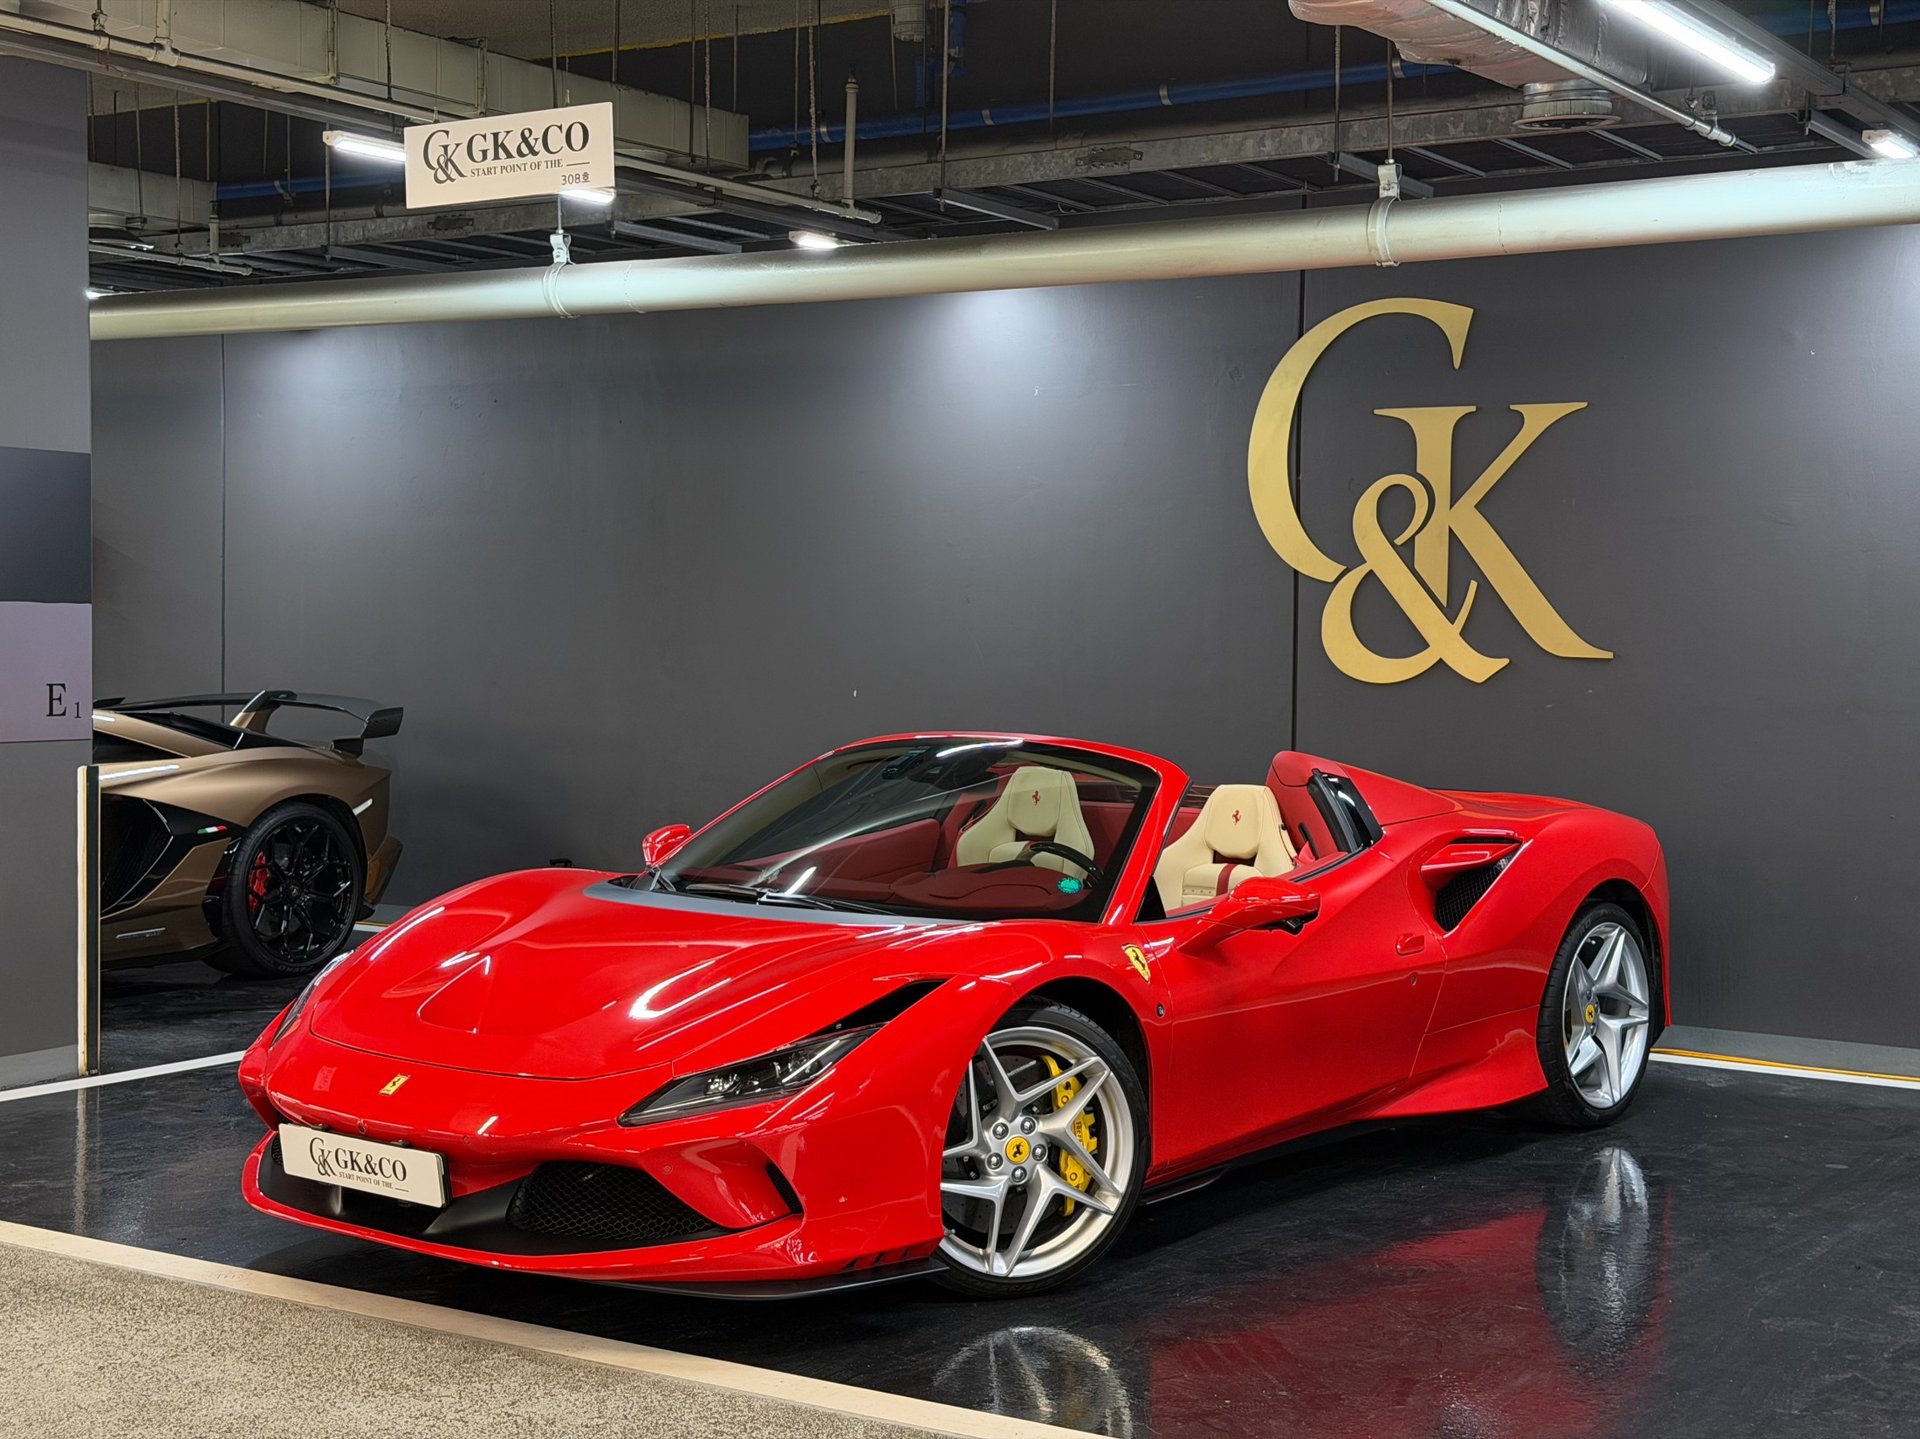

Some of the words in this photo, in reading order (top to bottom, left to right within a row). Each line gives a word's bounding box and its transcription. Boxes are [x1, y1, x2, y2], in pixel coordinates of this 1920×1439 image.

[466, 121, 590, 164] GK&CO
[470, 165, 498, 178] START
[500, 162, 528, 175] POINT
[530, 160, 543, 171] OF
[544, 158, 564, 170] THE
[561, 171, 591, 186] 308호
[334, 1147, 407, 1182] GK&CO
[338, 1171, 355, 1181] START
[355, 1174, 372, 1185] POINT
[381, 1180, 394, 1190] THE
